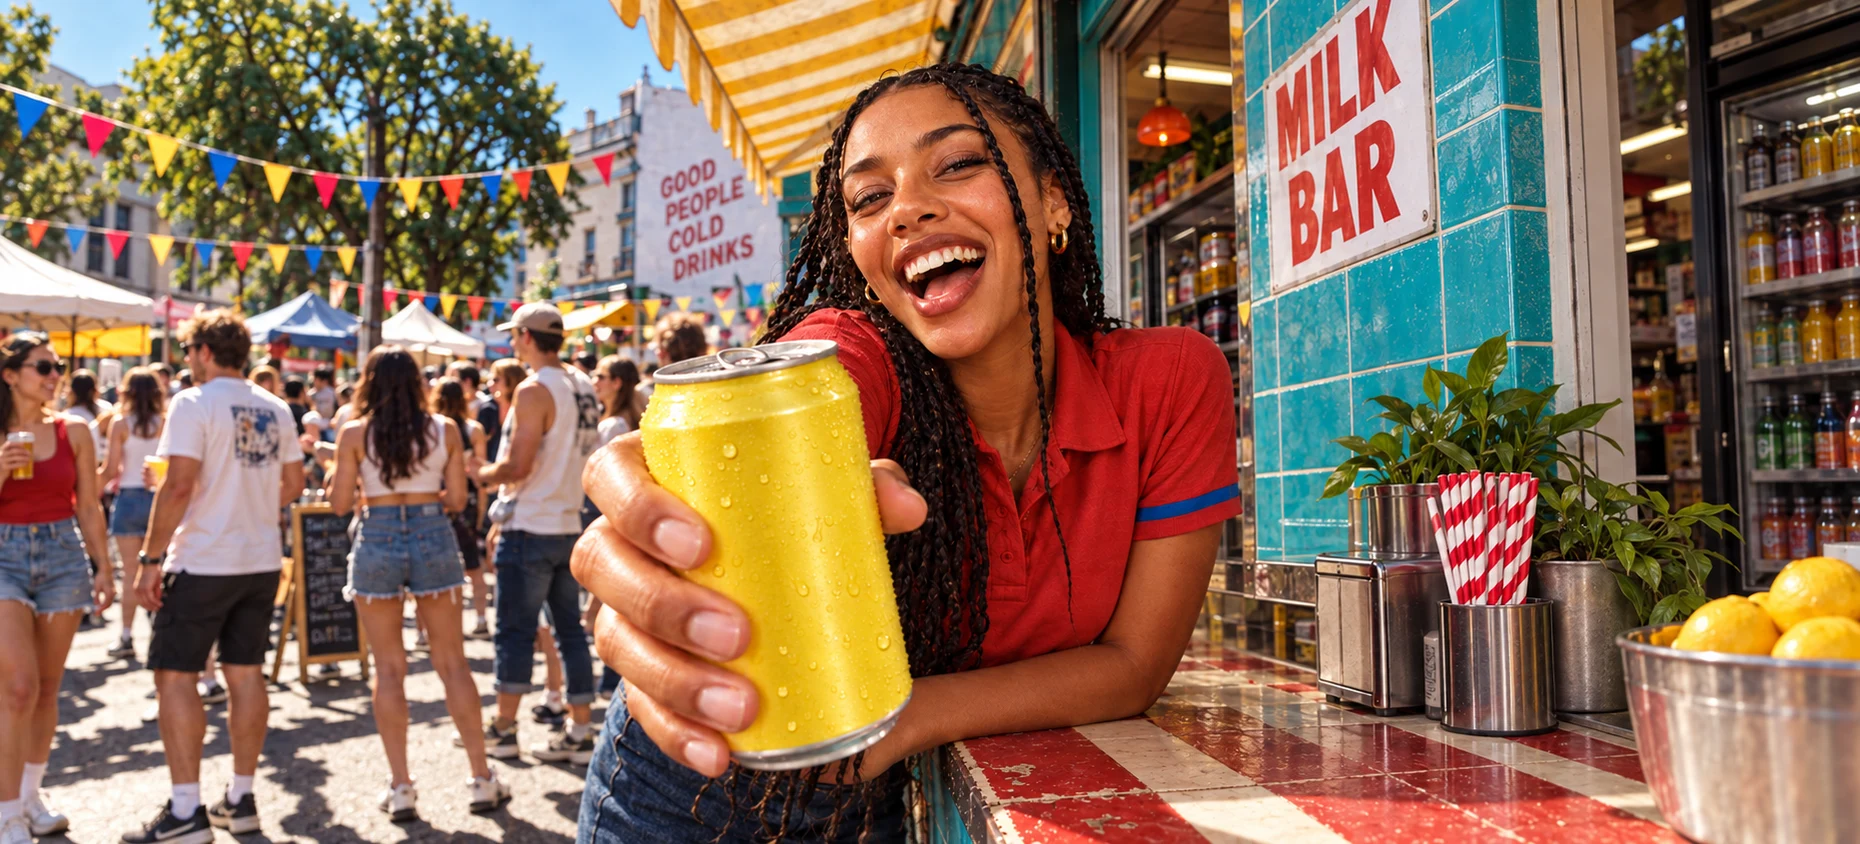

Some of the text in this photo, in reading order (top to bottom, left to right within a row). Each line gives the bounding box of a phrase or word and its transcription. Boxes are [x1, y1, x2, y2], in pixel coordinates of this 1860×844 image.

[1276, 0, 1401, 172] MILK
[660, 158, 716, 199] GOOD
[665, 175, 744, 226] PEOPLE
[1288, 119, 1401, 267] BAR
[668, 214, 724, 253] COLD
[673, 233, 754, 282] DRINKS
